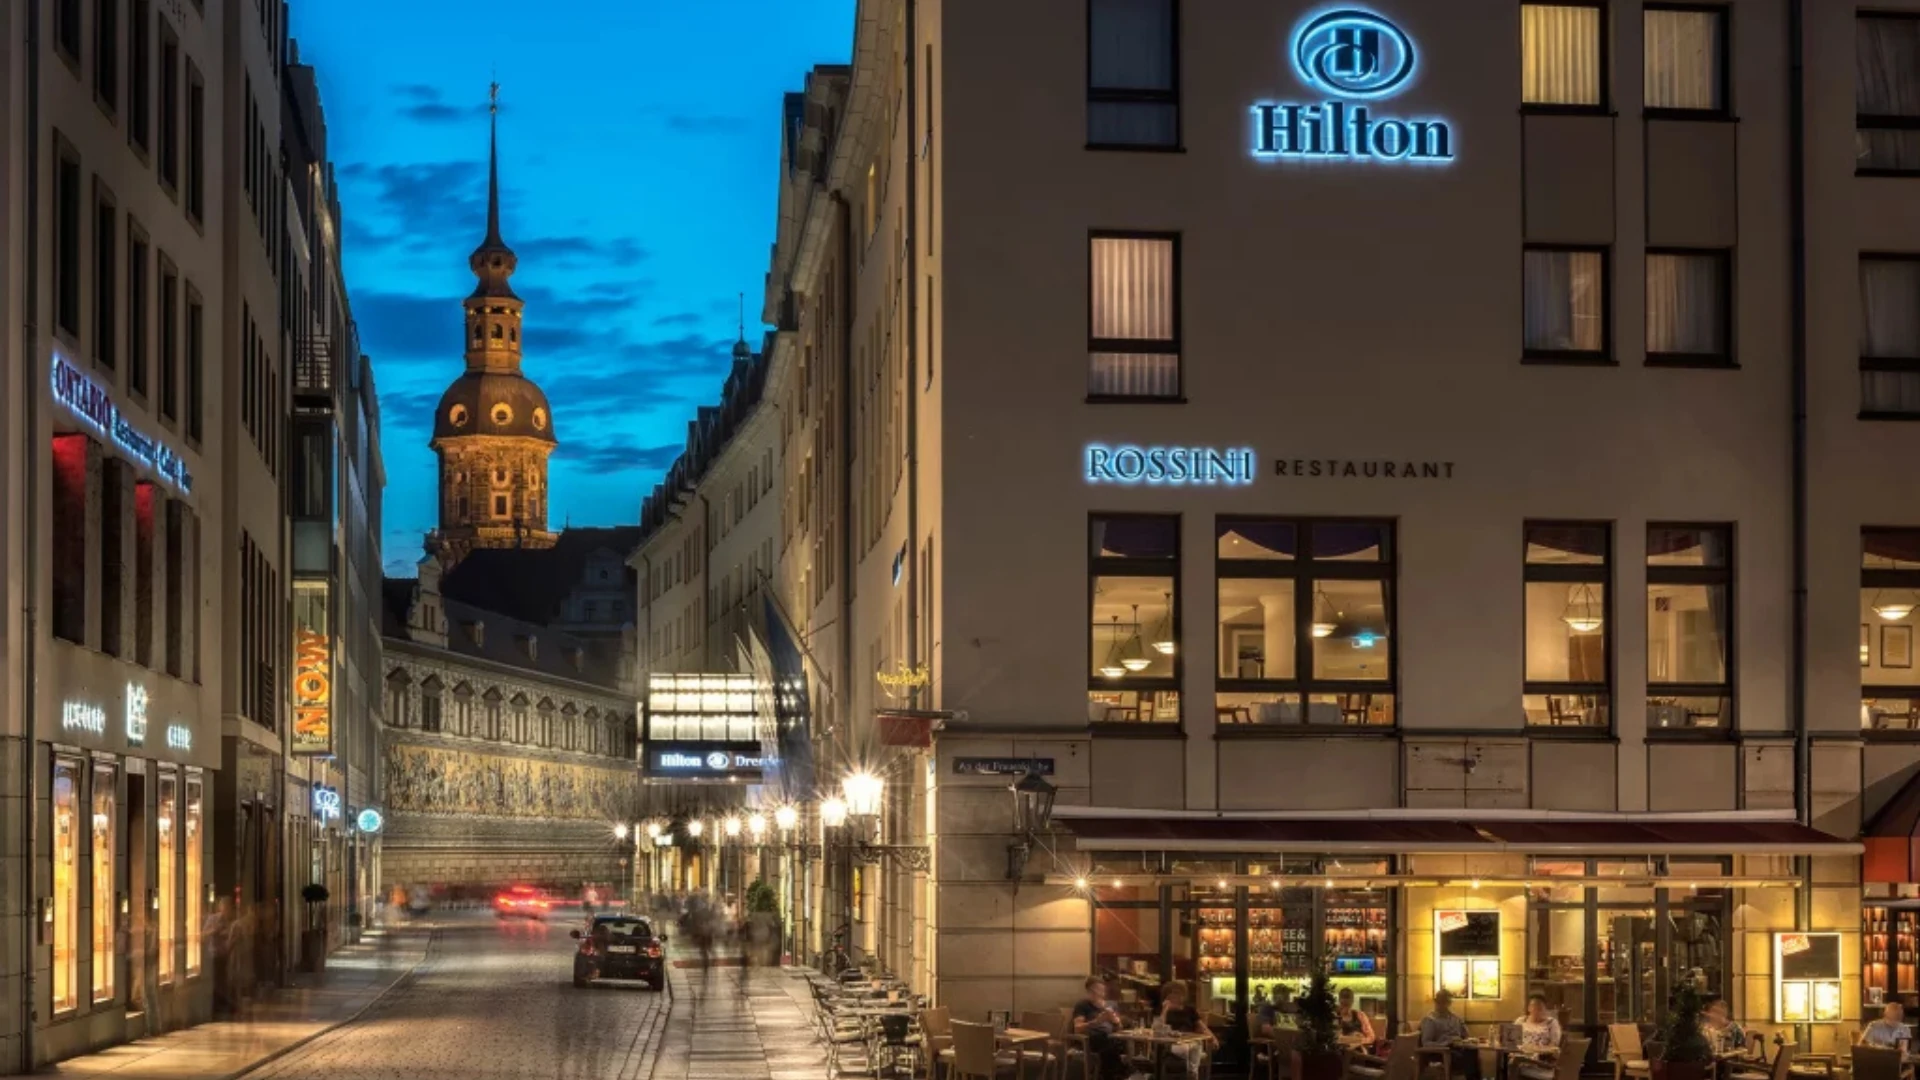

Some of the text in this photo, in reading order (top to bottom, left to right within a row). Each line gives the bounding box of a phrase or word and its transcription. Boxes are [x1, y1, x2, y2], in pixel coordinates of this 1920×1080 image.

[1252, 101, 1454, 160] Hilton
[54, 356, 111, 433] ONTARIO
[1087, 446, 1455, 483] ROSSINI RESTAURANT
[295, 627, 329, 735] NOW
[660, 753, 702, 767] Hilton
